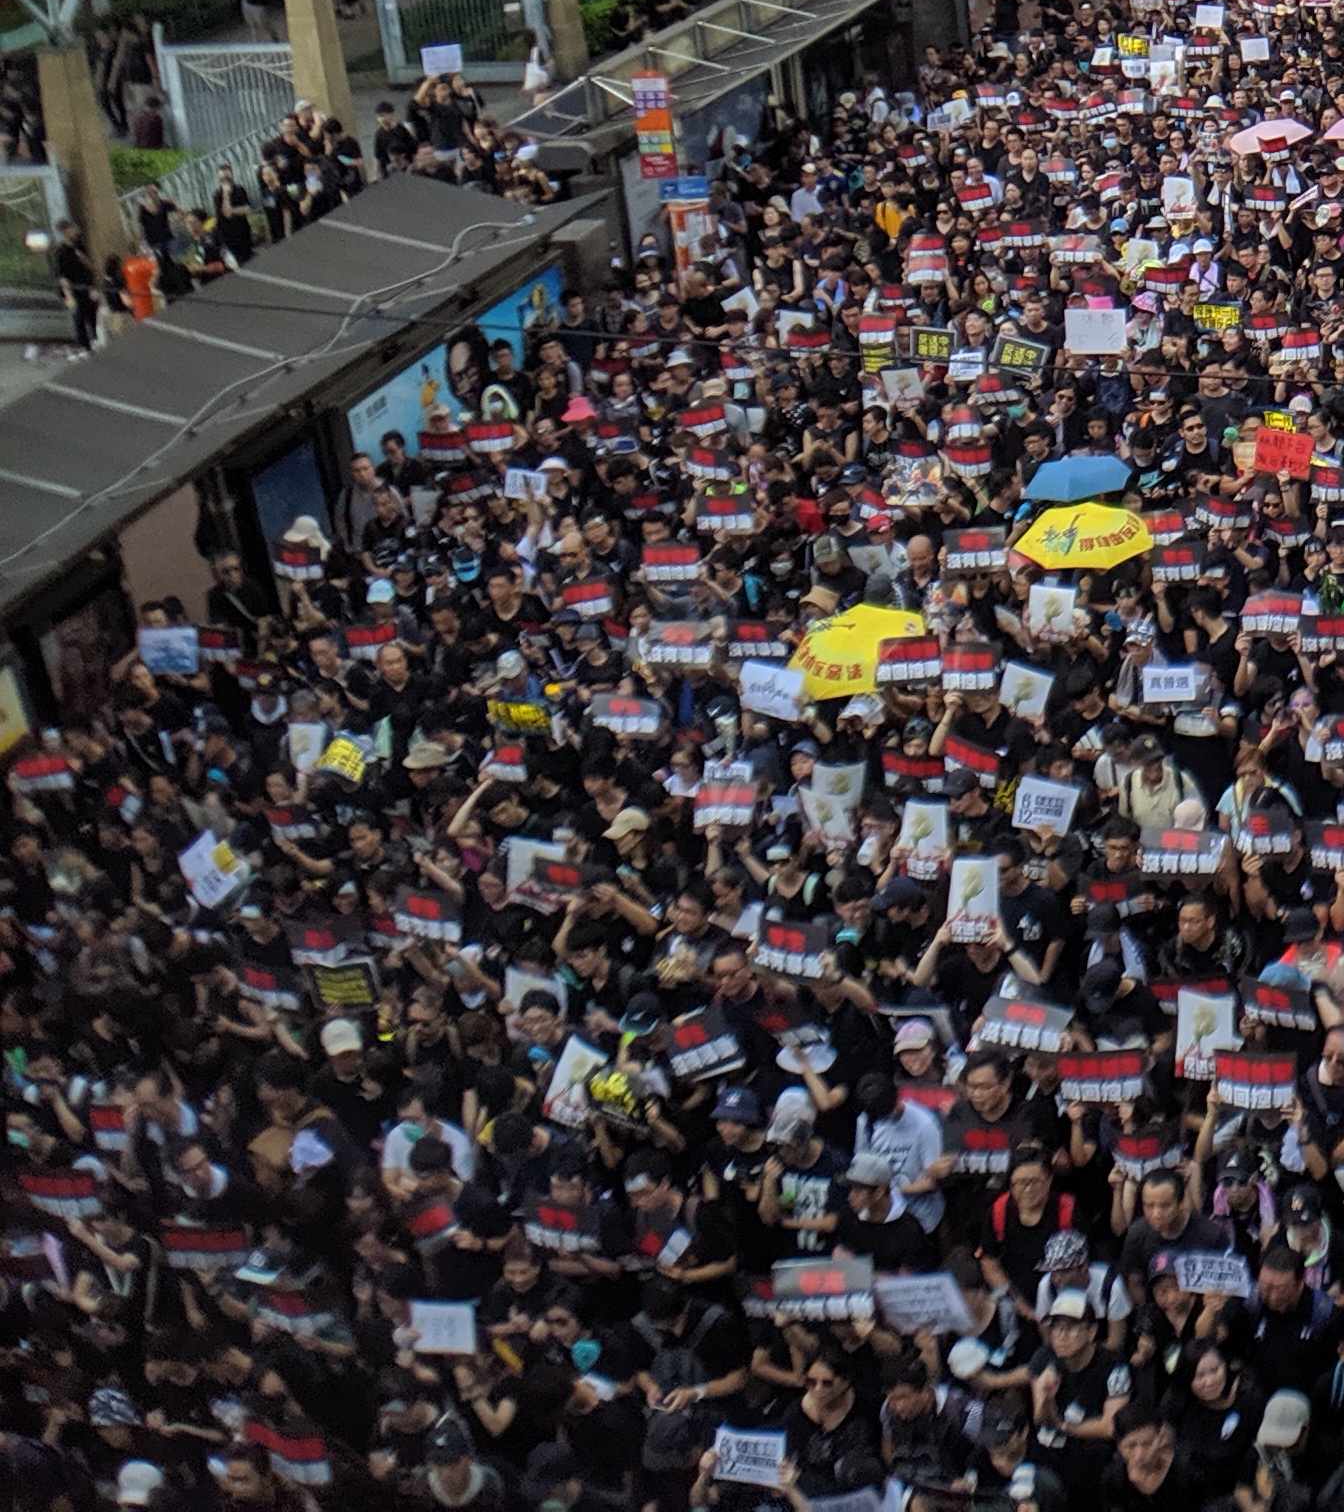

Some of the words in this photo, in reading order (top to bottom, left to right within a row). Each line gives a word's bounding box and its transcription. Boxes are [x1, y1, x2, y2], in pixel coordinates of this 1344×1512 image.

[1150, 677, 1189, 690] 真普選
[1021, 792, 1032, 809] 6
[1017, 808, 1032, 825] 12
